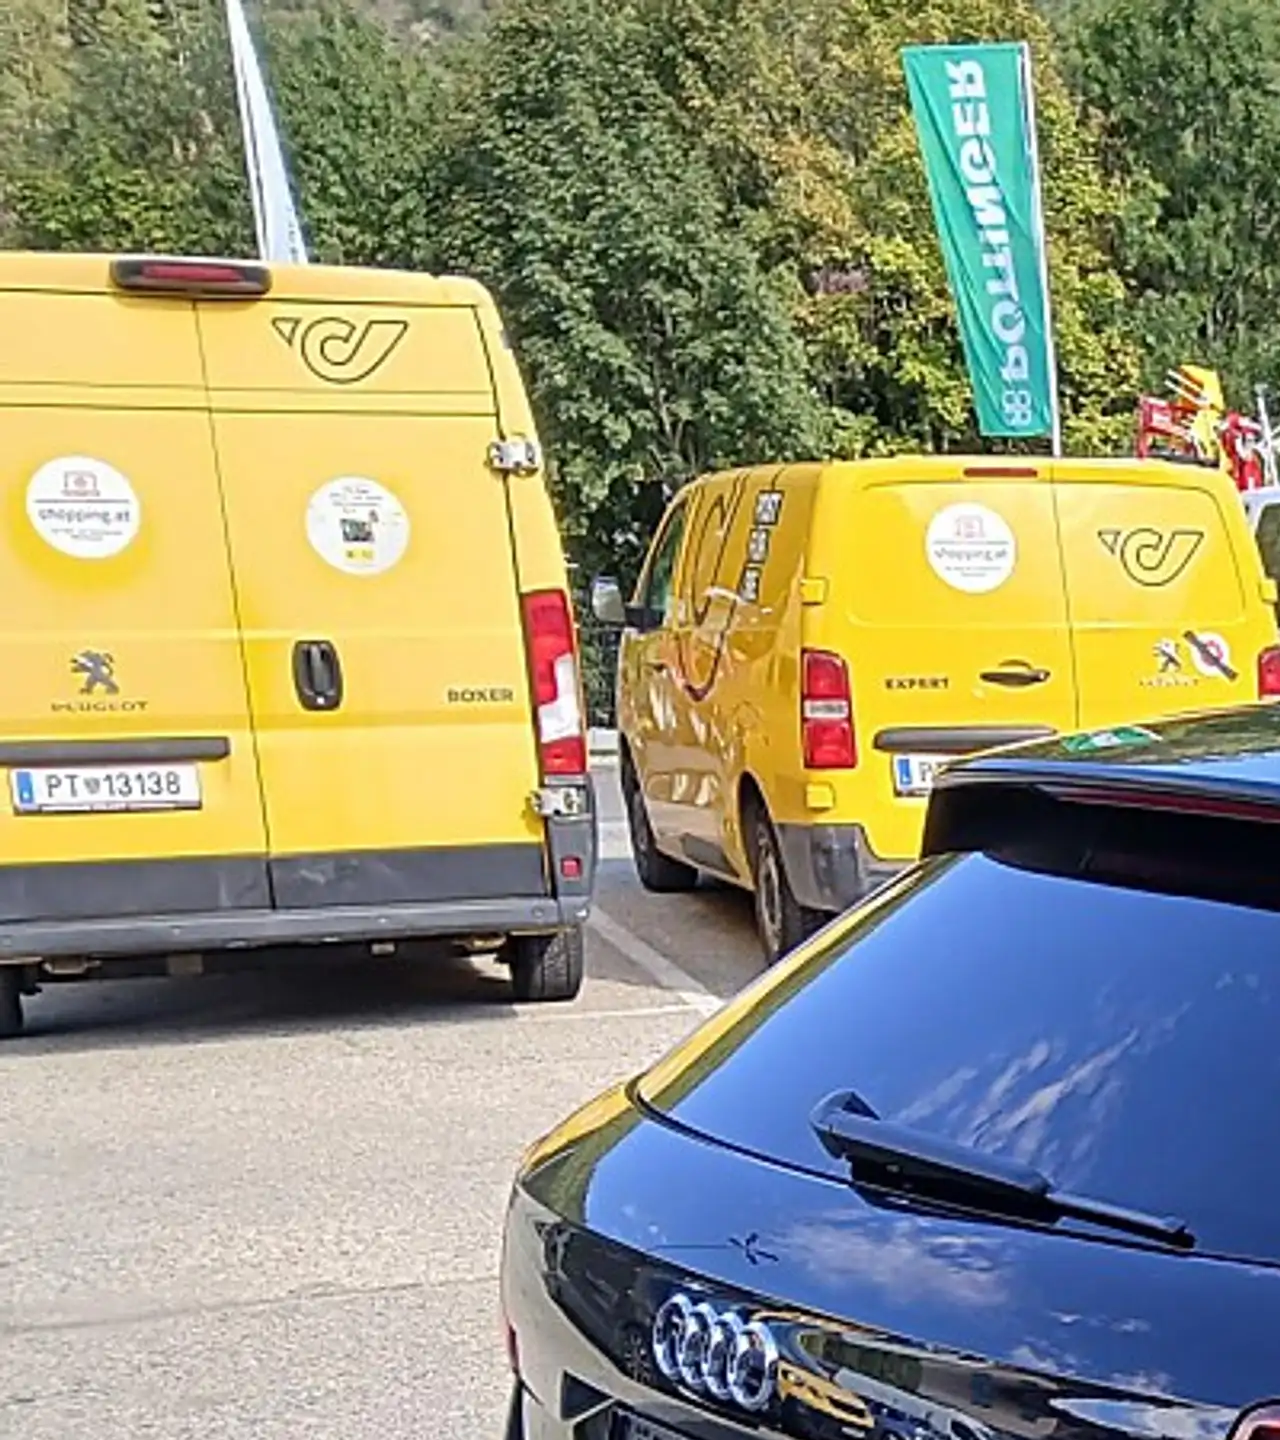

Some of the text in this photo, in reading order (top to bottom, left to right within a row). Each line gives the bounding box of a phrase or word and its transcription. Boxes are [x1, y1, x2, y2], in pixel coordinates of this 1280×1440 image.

[885, 677, 950, 690] EXPERT
[446, 687, 514, 703] BOXER
[103, 770, 181, 797] 13138
